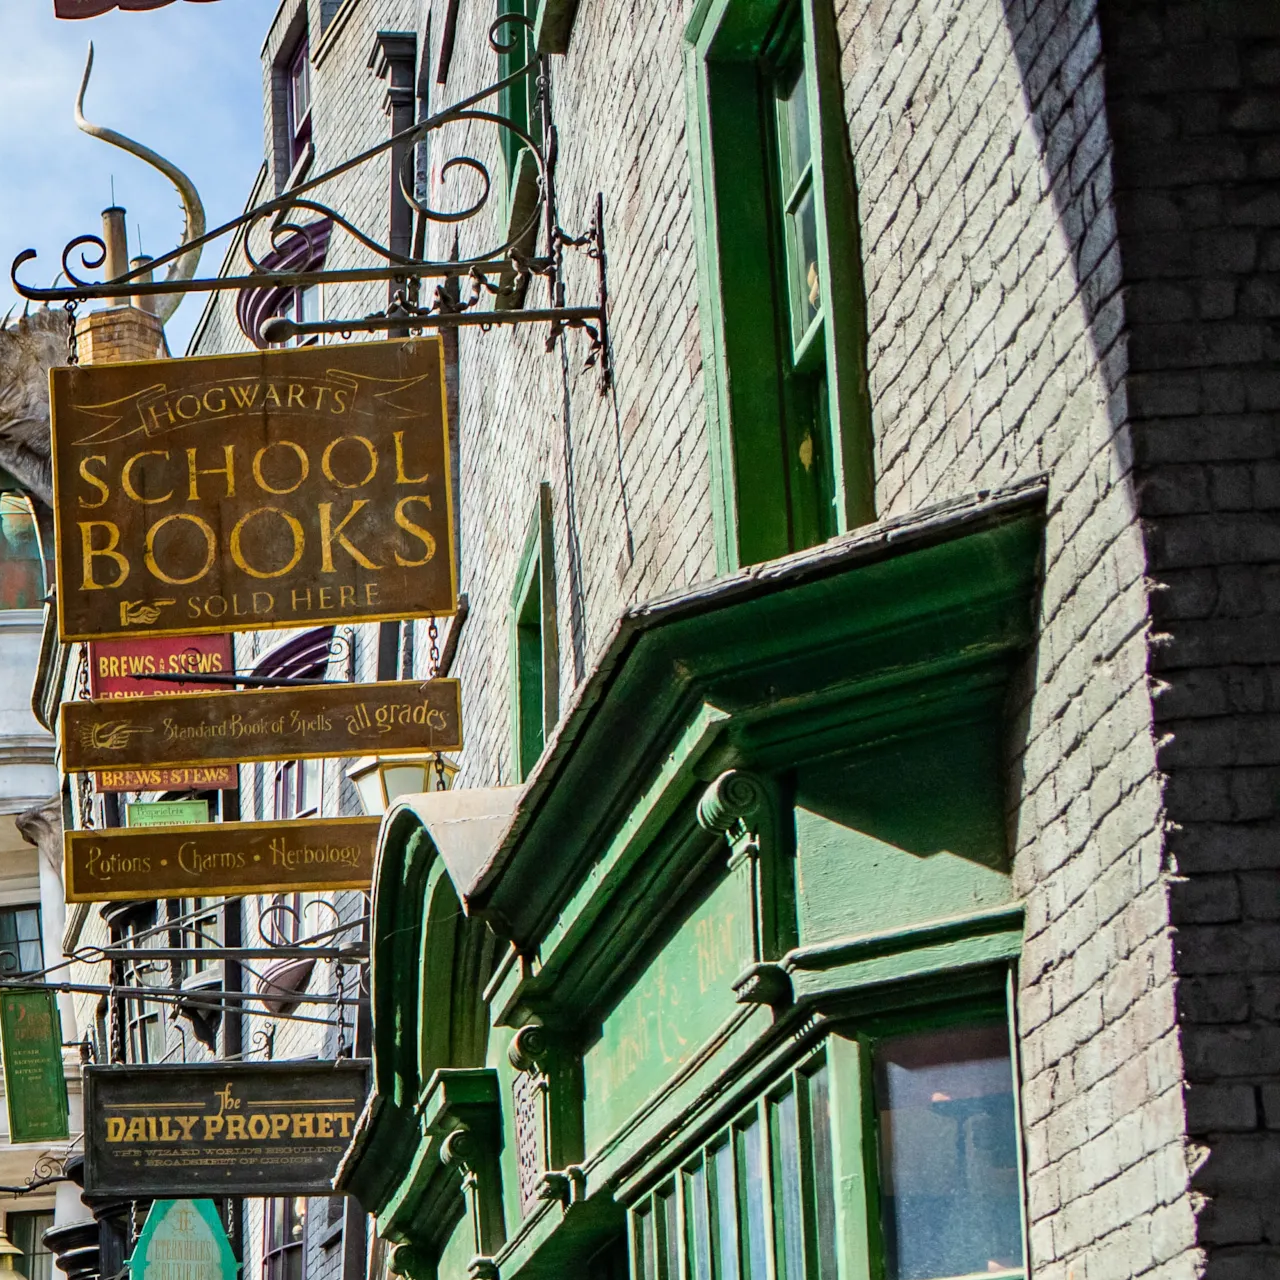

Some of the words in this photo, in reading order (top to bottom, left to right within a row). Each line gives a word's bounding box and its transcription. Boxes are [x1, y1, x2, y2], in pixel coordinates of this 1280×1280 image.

[148, 383, 348, 429] HOGWARTS
[78, 430, 429, 509] SCHOOL
[77, 495, 437, 592] BOOKS
[187, 591, 274, 619] SOLD
[291, 583, 382, 612] HERE
[99, 655, 156, 679] BREWS
[168, 652, 223, 675] STEWS
[162, 717, 227, 742] Standard
[228, 713, 269, 740] Book
[271, 715, 286, 735] of
[289, 709, 333, 737] Spells
[344, 702, 372, 736] all
[375, 699, 449, 734] grades
[101, 770, 162, 787] BREWS
[170, 767, 230, 785] STEWS
[85, 846, 152, 881] Potions
[177, 840, 246, 876] Charms
[268, 836, 362, 871] Herbology
[213, 1081, 241, 1117] The
[104, 1115, 201, 1143] DAILY
[202, 1111, 356, 1142] PROPHET
[113, 1149, 142, 1158] THE
[143, 1148, 201, 1158] WIZARD
[238, 1157, 257, 1166] OF
